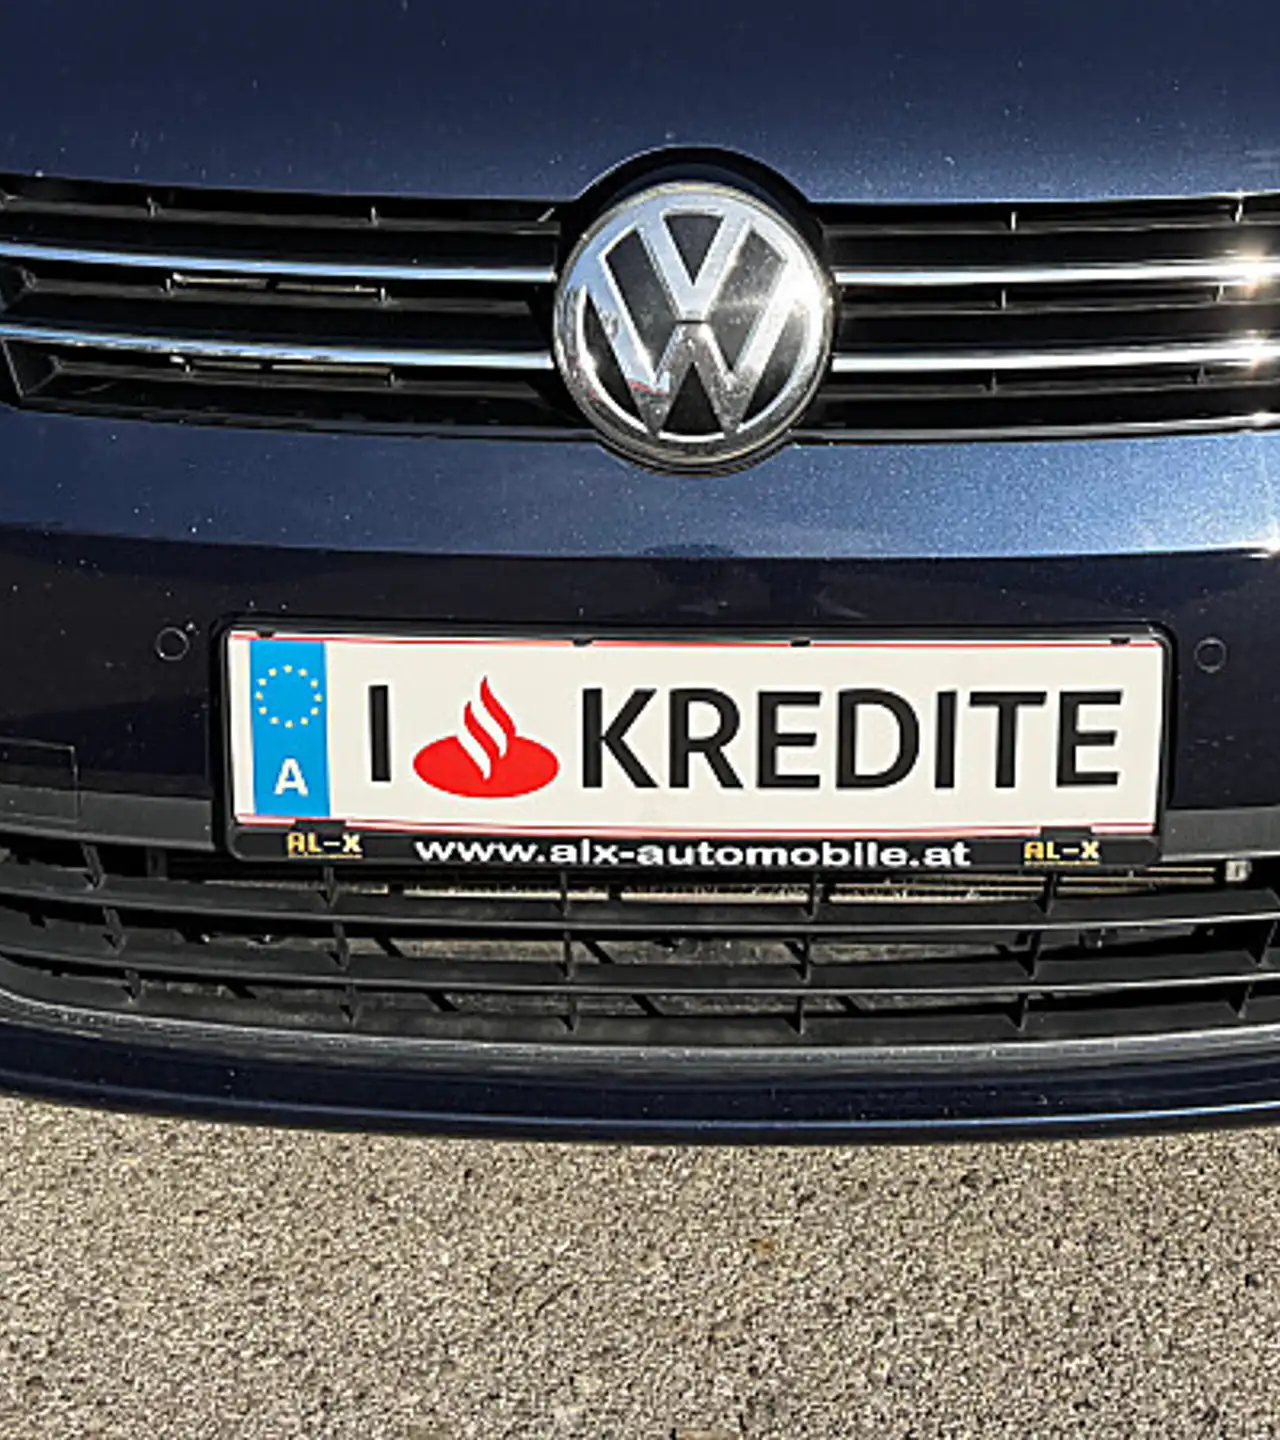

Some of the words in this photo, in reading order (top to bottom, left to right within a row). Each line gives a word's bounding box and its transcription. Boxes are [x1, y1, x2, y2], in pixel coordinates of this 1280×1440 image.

[368, 684, 391, 782] I
[582, 687, 1124, 790] KREDITE
[273, 757, 309, 797] A
[286, 832, 363, 855] AL-X
[413, 838, 971, 868] www.alx-automobile.at
[1023, 841, 1099, 862] AL-X
